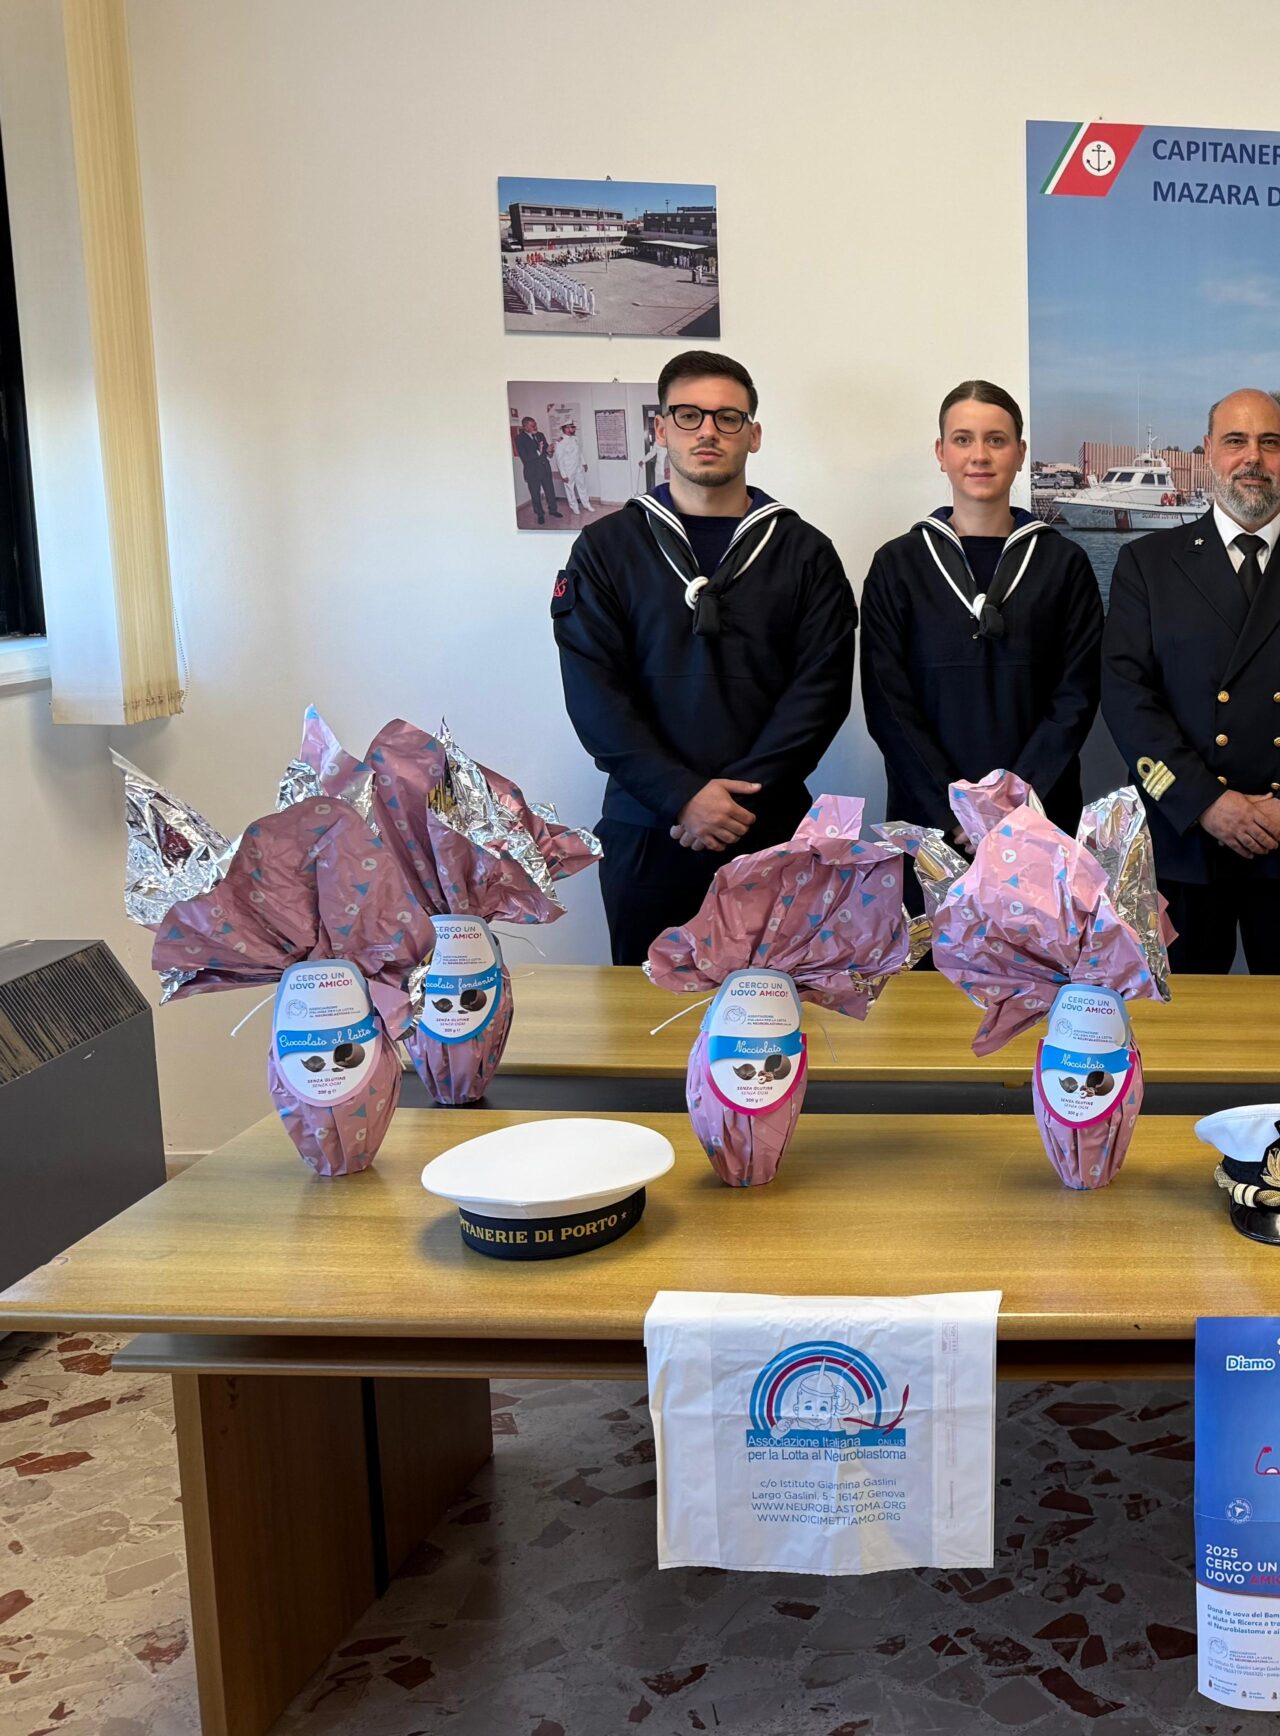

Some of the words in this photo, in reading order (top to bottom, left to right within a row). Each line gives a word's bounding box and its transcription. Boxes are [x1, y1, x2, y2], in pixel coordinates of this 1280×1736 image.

[1153, 181, 1259, 206] MAZARA
[296, 973, 328, 982] CERCO
[290, 982, 315, 990] UOVO
[318, 979, 353, 988] AMICO!
[738, 981, 768, 989] CERCO
[759, 990, 788, 998] AMICO!
[1068, 996, 1095, 1005] CERCO
[1061, 1003, 1083, 1012] UOVO
[1085, 1006, 1116, 1016] AMICO!
[279, 1033, 327, 1047] Cioccolato
[331, 1031, 344, 1045] al
[347, 1029, 371, 1041] latte
[734, 1040, 782, 1053] Nocciolato
[1060, 1053, 1105, 1069] Nocciolato
[534, 1229, 554, 1243] DI
[561, 1214, 618, 1240] PORTO
[1227, 1355, 1275, 1371] Diamo
[747, 1435, 819, 1448] Associazione
[823, 1436, 861, 1449] Italiana
[748, 1451, 767, 1463] per
[769, 1449, 779, 1460] la
[782, 1449, 809, 1461] Lotta
[812, 1449, 821, 1460] al
[825, 1448, 906, 1462] Neuroblastoma
[760, 1479, 777, 1488] c/o
[780, 1479, 815, 1488] Istituto
[818, 1479, 860, 1490] Giannina
[863, 1478, 896, 1487] Gaslini
[752, 1492, 781, 1502] Largo
[822, 1492, 829, 1501] 5
[868, 1489, 905, 1499] Genova
[751, 1501, 906, 1514] WWW.NEUROBLASTOMA.ORG
[1206, 1544, 1238, 1558] 2025
[1206, 1557, 1253, 1572] CERCO
[1257, 1562, 1277, 1572] UN
[1206, 1568, 1245, 1584] UOVO
